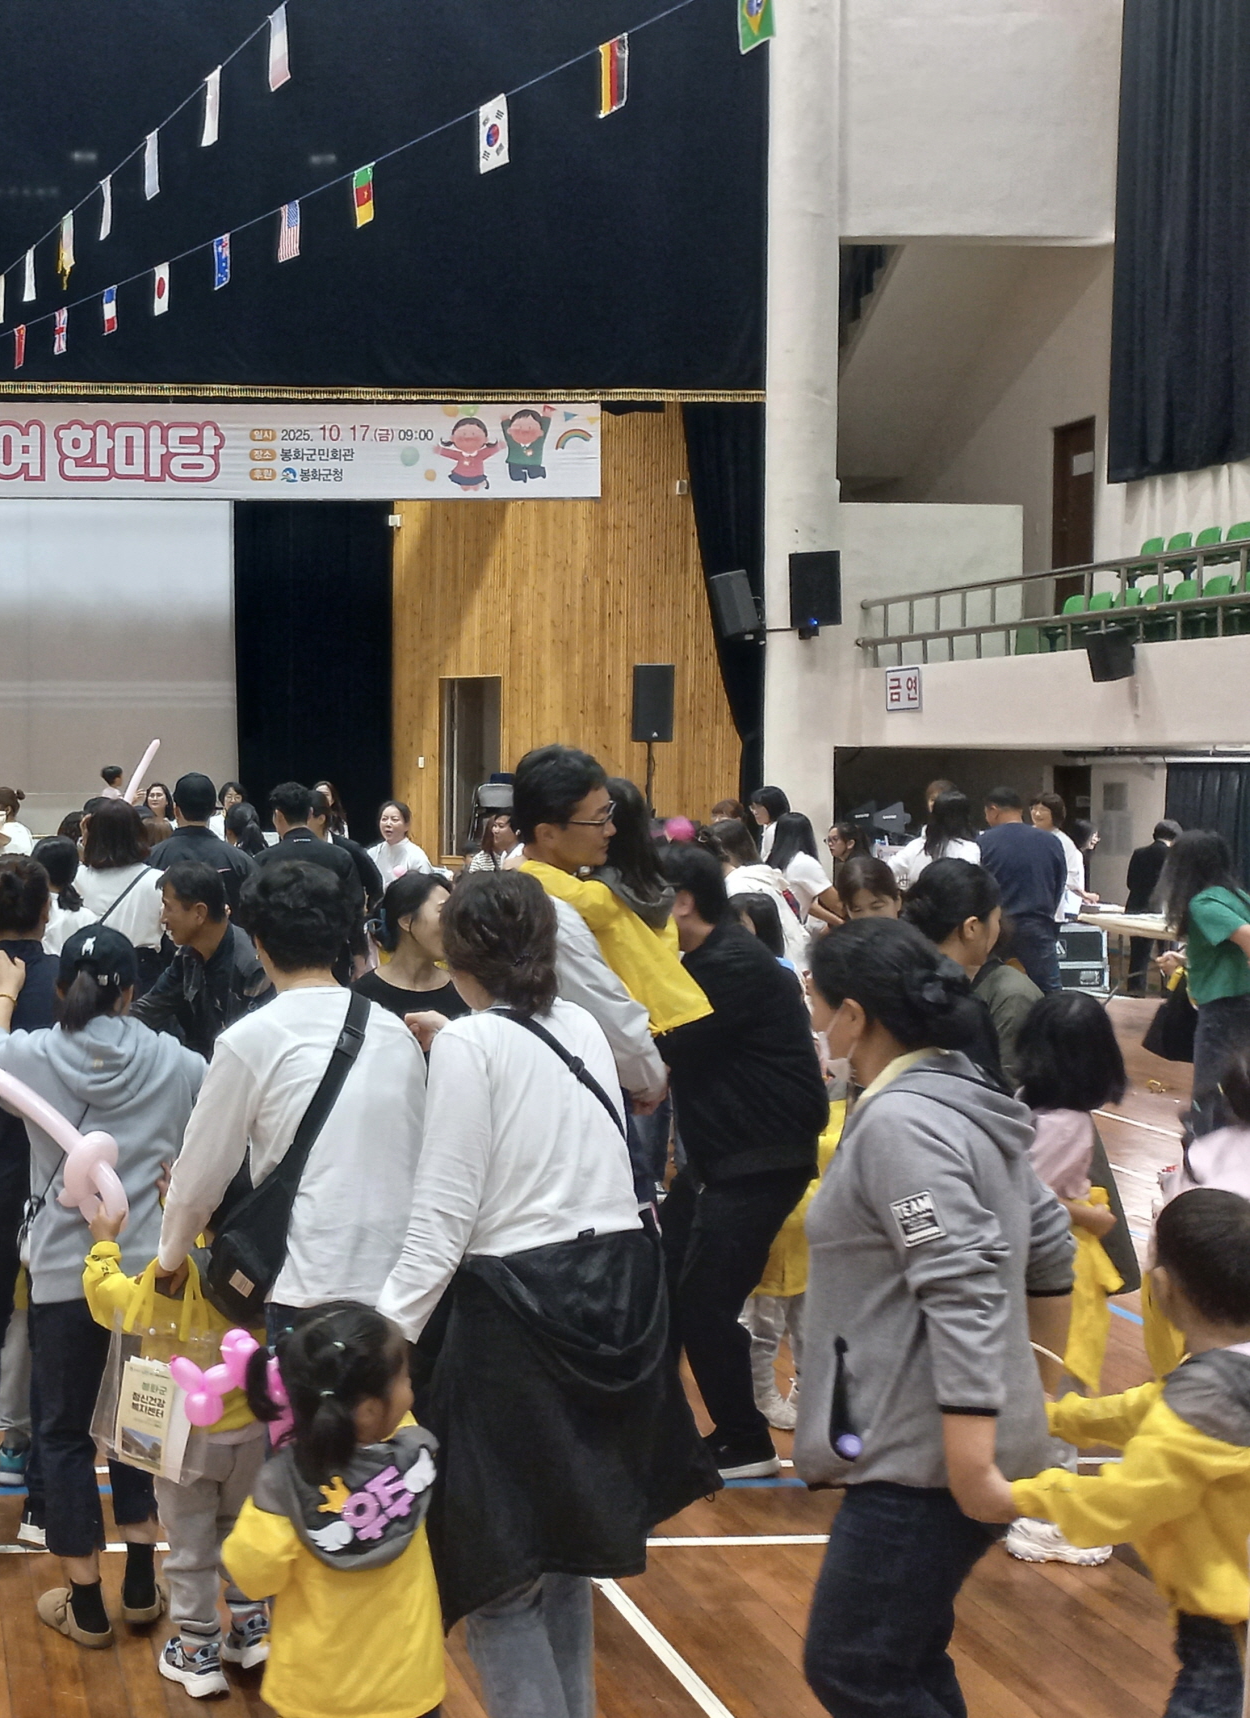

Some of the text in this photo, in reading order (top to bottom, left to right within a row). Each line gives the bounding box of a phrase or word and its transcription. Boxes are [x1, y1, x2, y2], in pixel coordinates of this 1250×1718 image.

[253, 429, 273, 441] 일시
[281, 429, 313, 442] 2025.
[399, 429, 434, 441] 09:00
[54, 419, 225, 483] 한마당
[253, 448, 355, 462] 장소 봉화군민회관
[300, 468, 344, 482] 봉화군청
